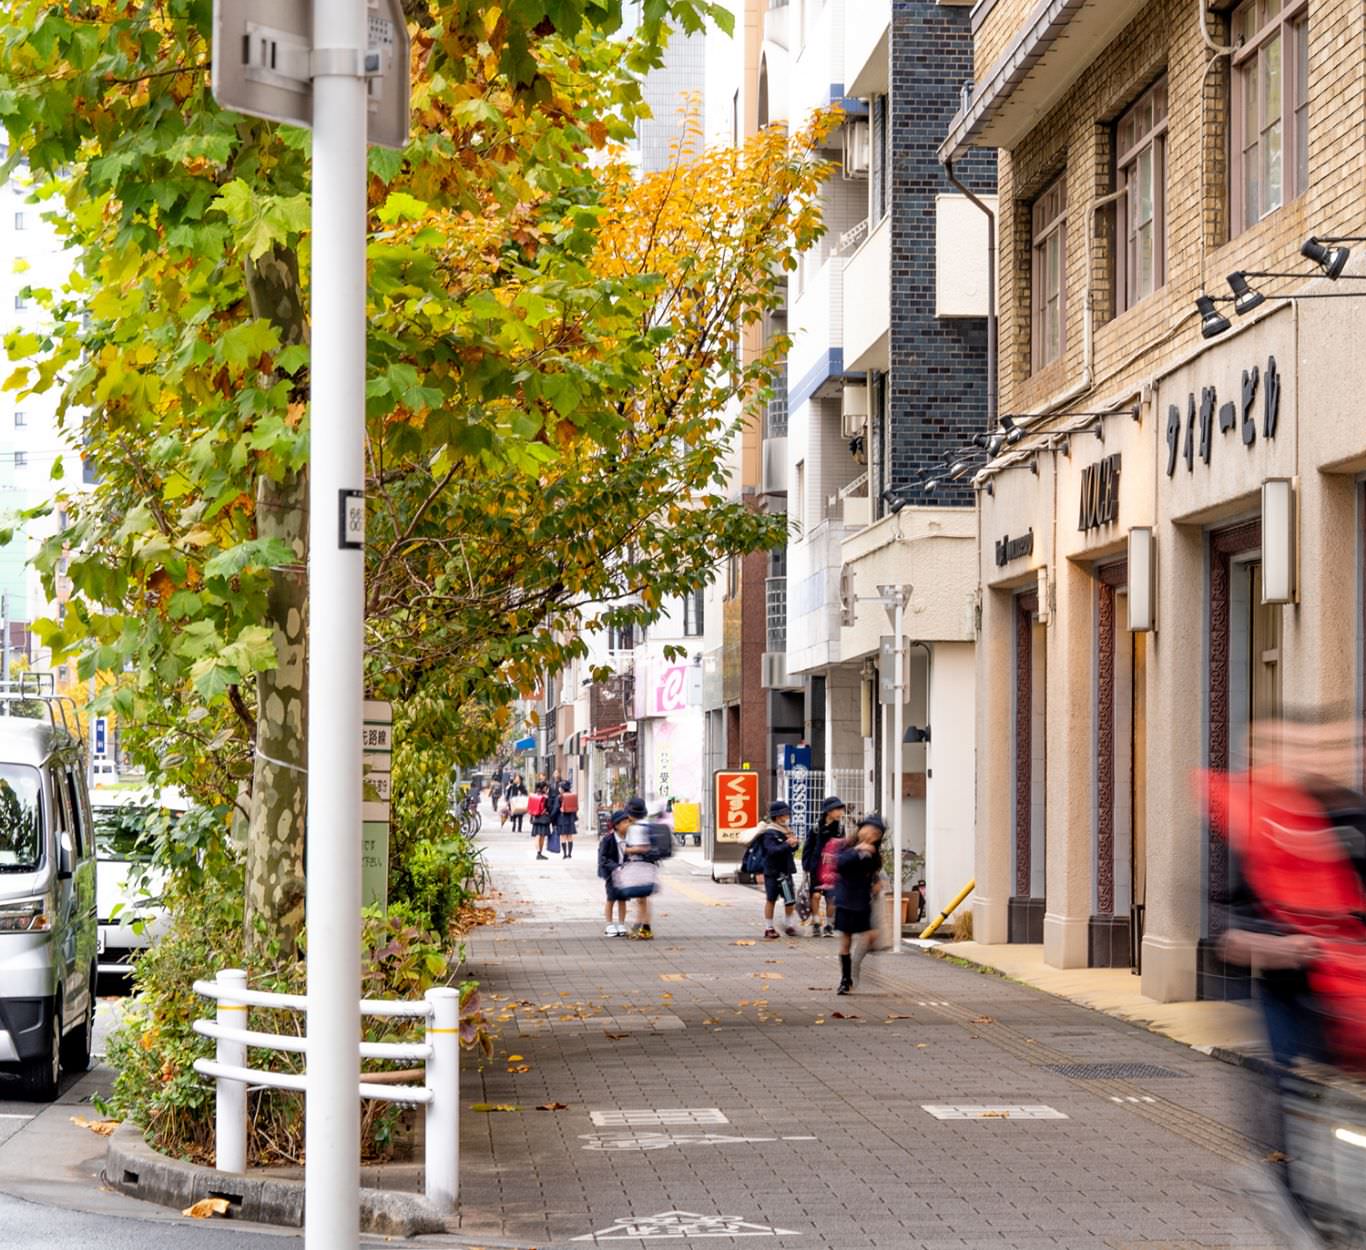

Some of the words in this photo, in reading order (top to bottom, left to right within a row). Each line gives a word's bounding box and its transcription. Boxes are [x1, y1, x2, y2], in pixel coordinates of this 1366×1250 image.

[1166, 355, 1281, 478] タイガービル
[1077, 453, 1122, 532] NOCE
[725, 775, 751, 828] くすり
[791, 783, 807, 825] BOSS
